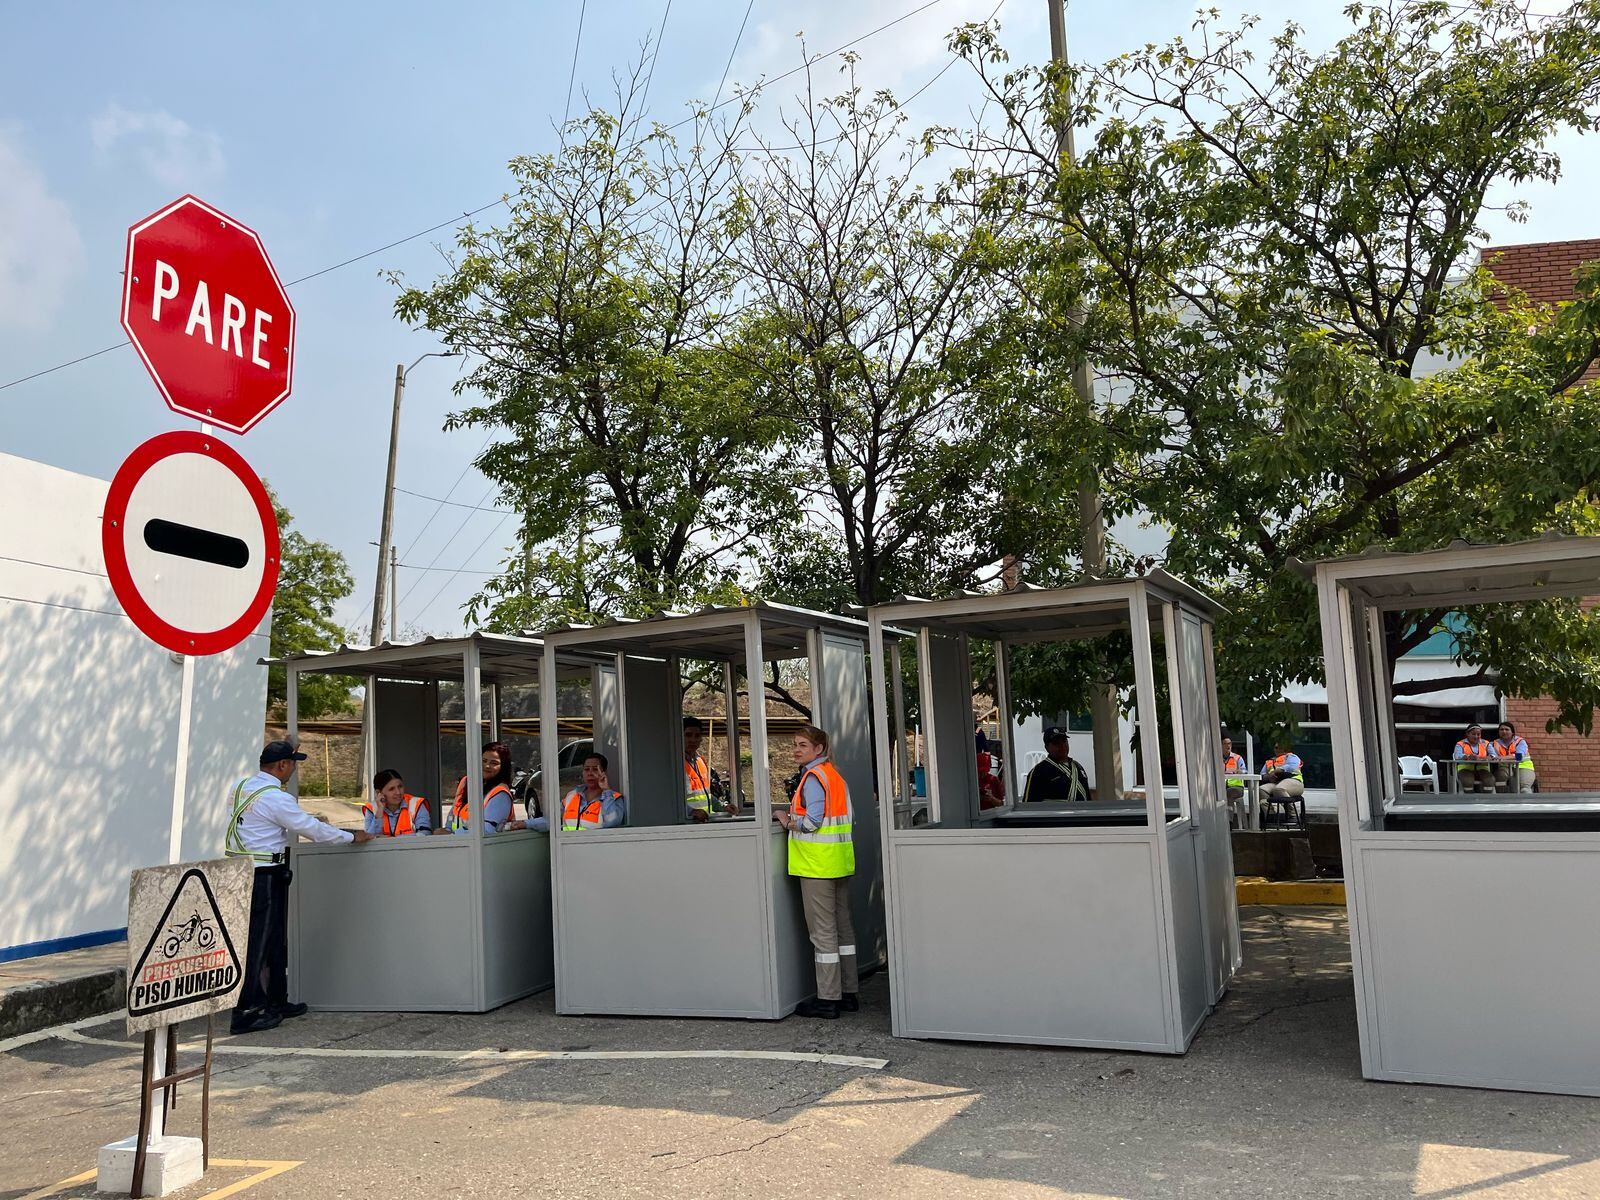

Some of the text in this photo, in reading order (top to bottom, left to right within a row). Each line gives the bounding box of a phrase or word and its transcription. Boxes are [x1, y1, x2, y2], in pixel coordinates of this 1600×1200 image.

[151, 259, 273, 370] PARE
[135, 965, 234, 1008] PISO HUMEDO
